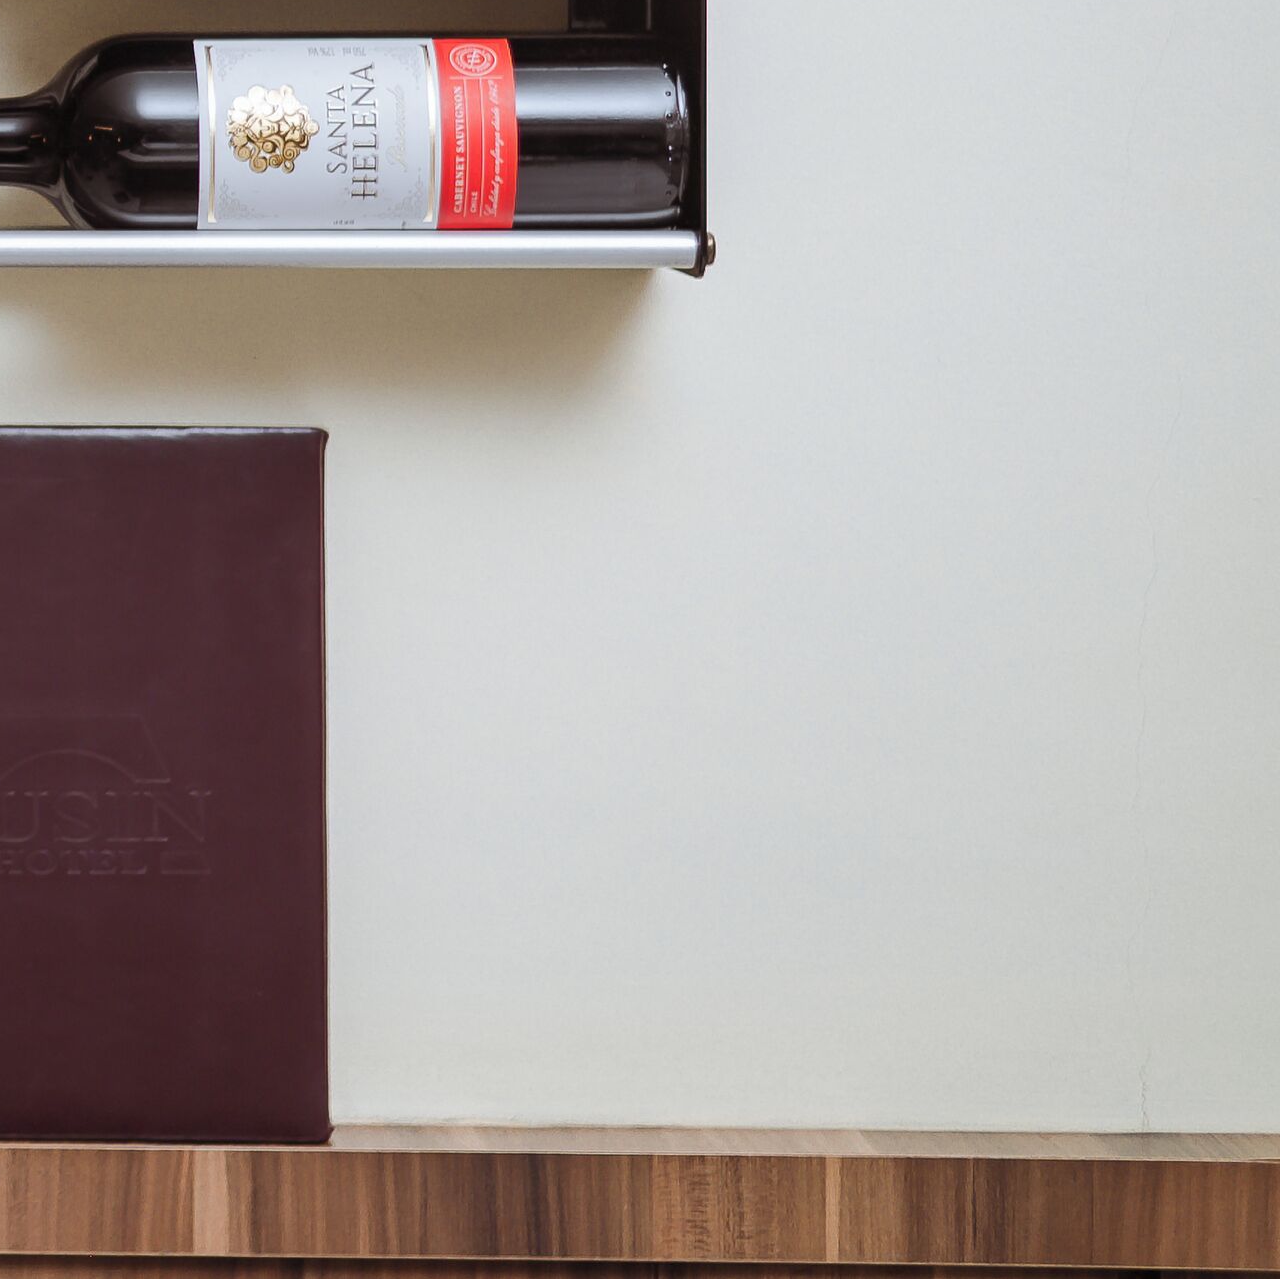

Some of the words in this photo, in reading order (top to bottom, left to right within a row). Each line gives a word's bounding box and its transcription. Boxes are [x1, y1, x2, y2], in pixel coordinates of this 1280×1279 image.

[326, 84, 350, 175] SANTA
[350, 62, 379, 201] HELENA
[452, 85, 466, 154] SAUVIGNON
[452, 155, 466, 214] CABERNET
[469, 190, 478, 214] CHILE
